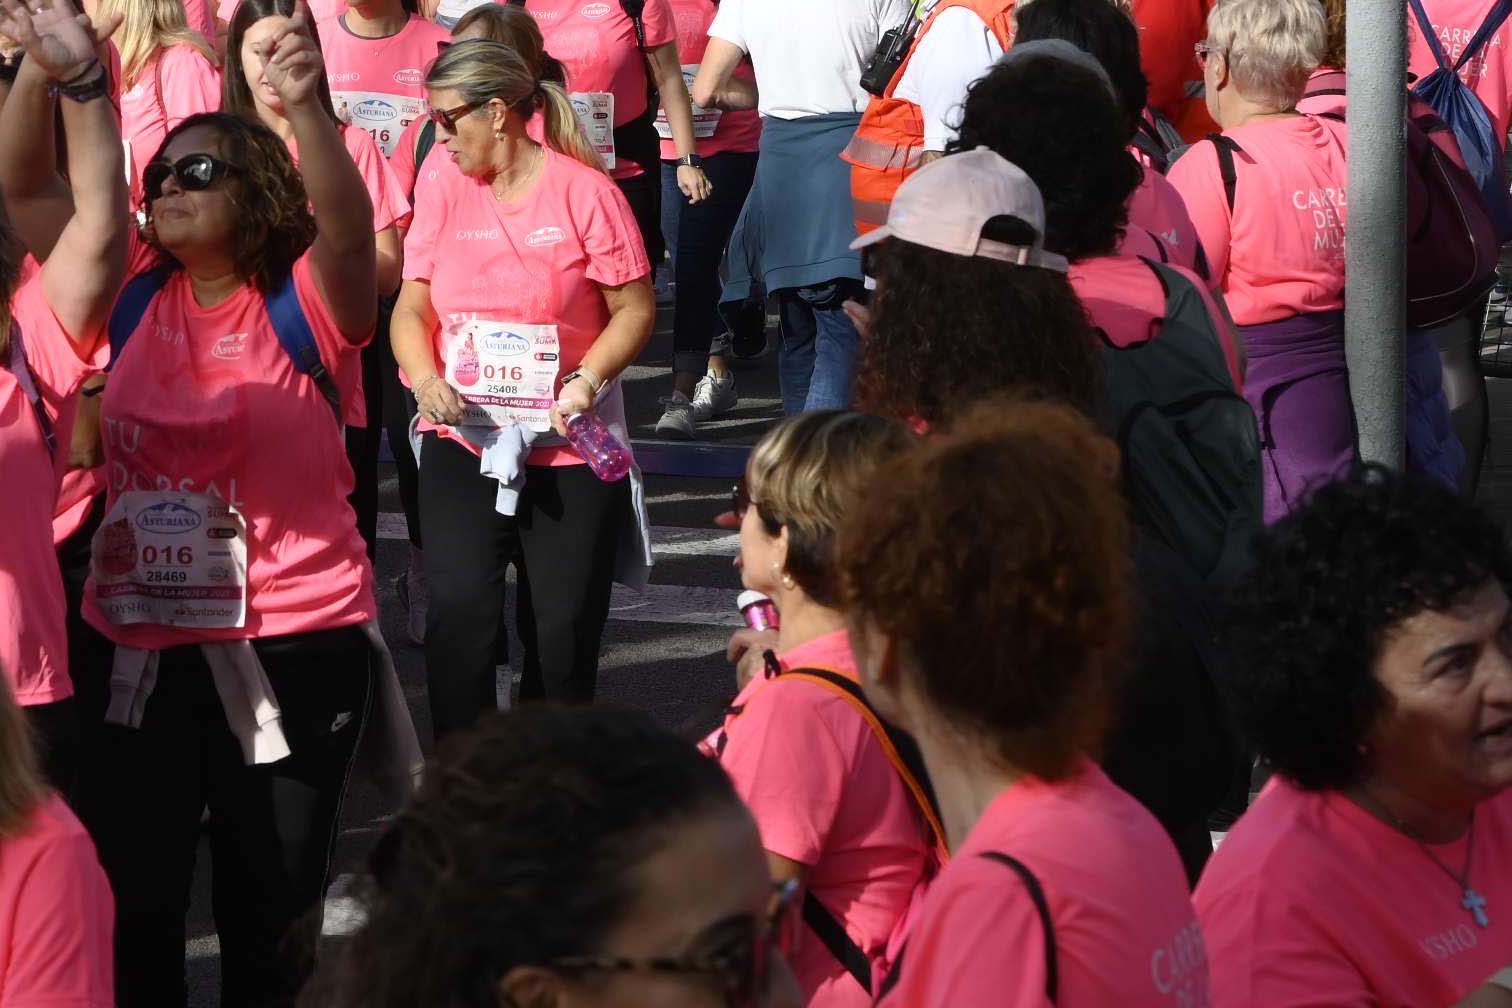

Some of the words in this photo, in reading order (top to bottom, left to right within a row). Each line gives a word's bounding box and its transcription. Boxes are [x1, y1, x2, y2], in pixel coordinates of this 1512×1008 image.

[358, 105, 394, 118] ASTURIANA
[369, 128, 390, 142] 16
[1292, 186, 1346, 211] CARRE
[456, 228, 499, 242] OYSHO
[484, 337, 527, 351] ASTURIANA
[483, 364, 523, 382] 016
[487, 381, 518, 394] 25408
[142, 515, 197, 527] ASTURIANA
[142, 545, 193, 565] 016
[146, 570, 187, 583] 28469
